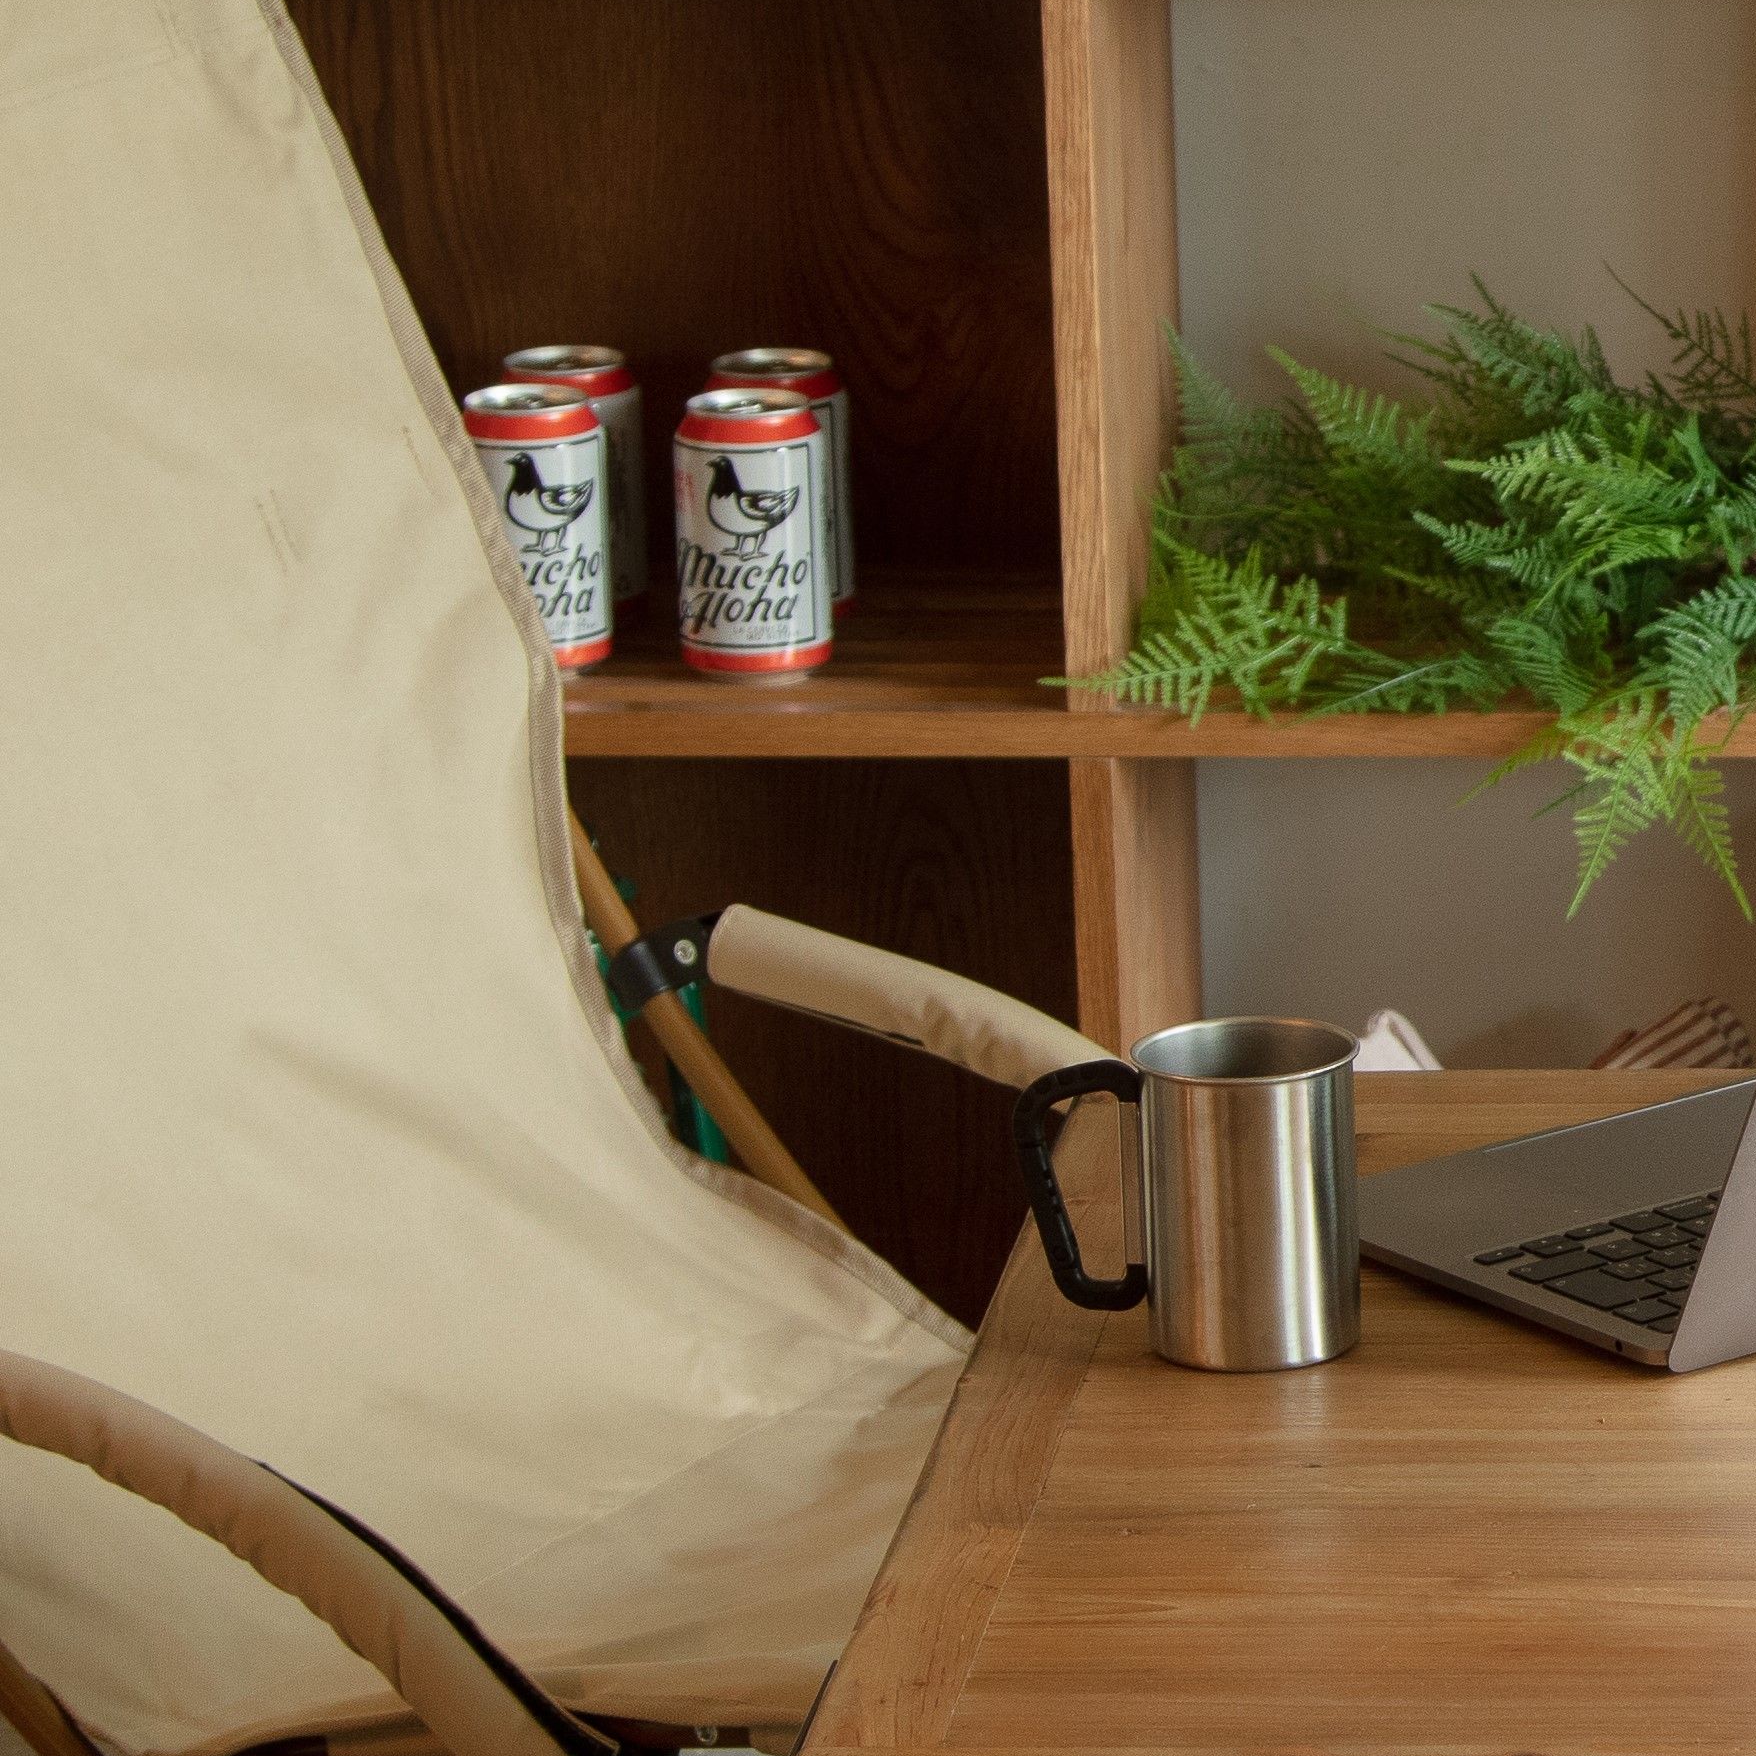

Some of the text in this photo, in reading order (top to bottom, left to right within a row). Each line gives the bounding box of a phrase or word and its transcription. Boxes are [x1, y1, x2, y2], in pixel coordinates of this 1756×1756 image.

[520, 544, 600, 585] ucho
[679, 537, 807, 590] Mucho
[681, 585, 799, 635] Aloha
